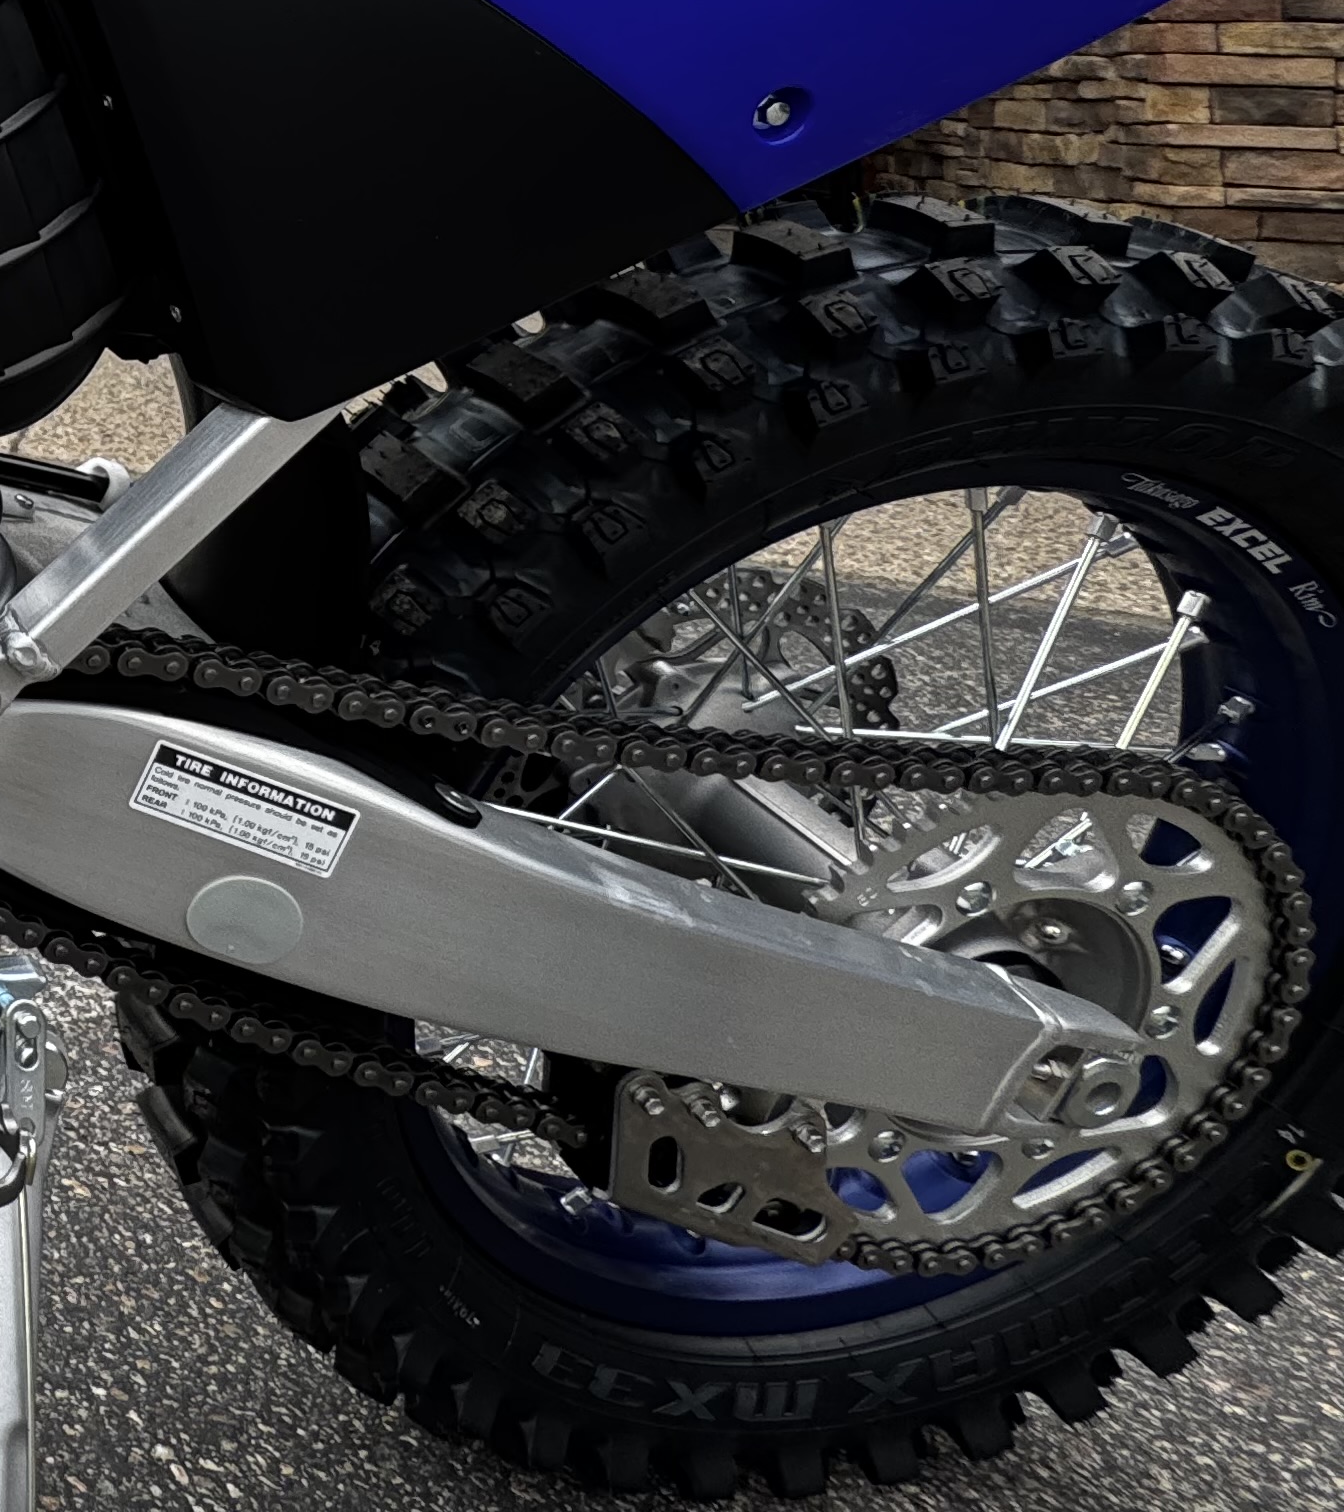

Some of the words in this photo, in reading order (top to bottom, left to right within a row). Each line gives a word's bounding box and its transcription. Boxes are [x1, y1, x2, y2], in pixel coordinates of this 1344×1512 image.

[1195, 505, 1293, 574] EXCEL
[146, 784, 179, 801] FRONT
[194, 801, 209, 812] 100
[175, 753, 214, 778] TIRE
[219, 770, 337, 822] INFORMATION
[194, 781, 224, 796] normal
[225, 793, 261, 811] pressure
[141, 794, 168, 809] REAR
[189, 811, 204, 822] 100
